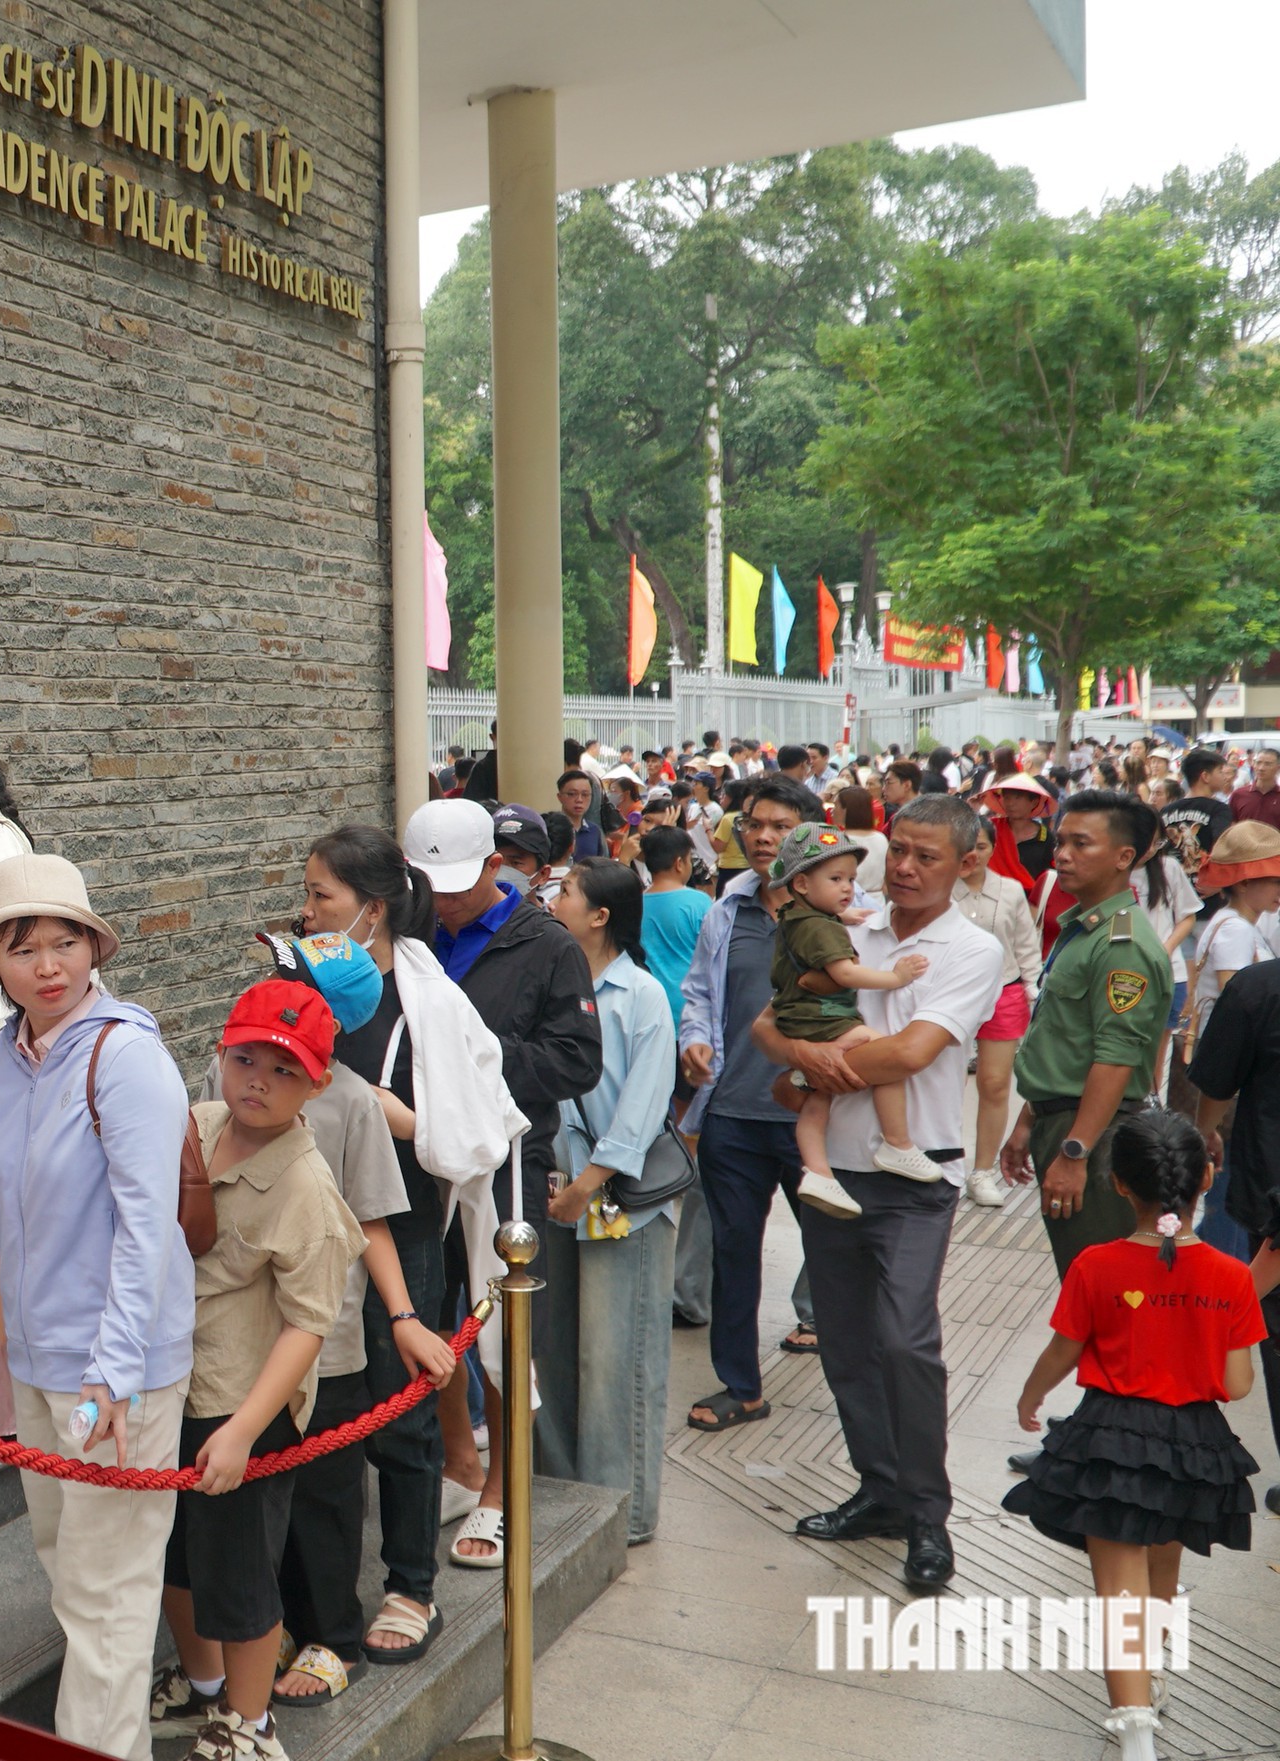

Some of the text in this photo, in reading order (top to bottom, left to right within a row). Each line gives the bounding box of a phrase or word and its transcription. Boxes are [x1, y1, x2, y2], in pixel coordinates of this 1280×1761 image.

[40, 46, 76, 118] SỬ
[81, 43, 175, 161] DINH
[184, 90, 251, 209] ĐỘC
[257, 125, 314, 226] LẬP
[114, 174, 208, 264] PALACE
[228, 236, 329, 306] HISTORICAL
